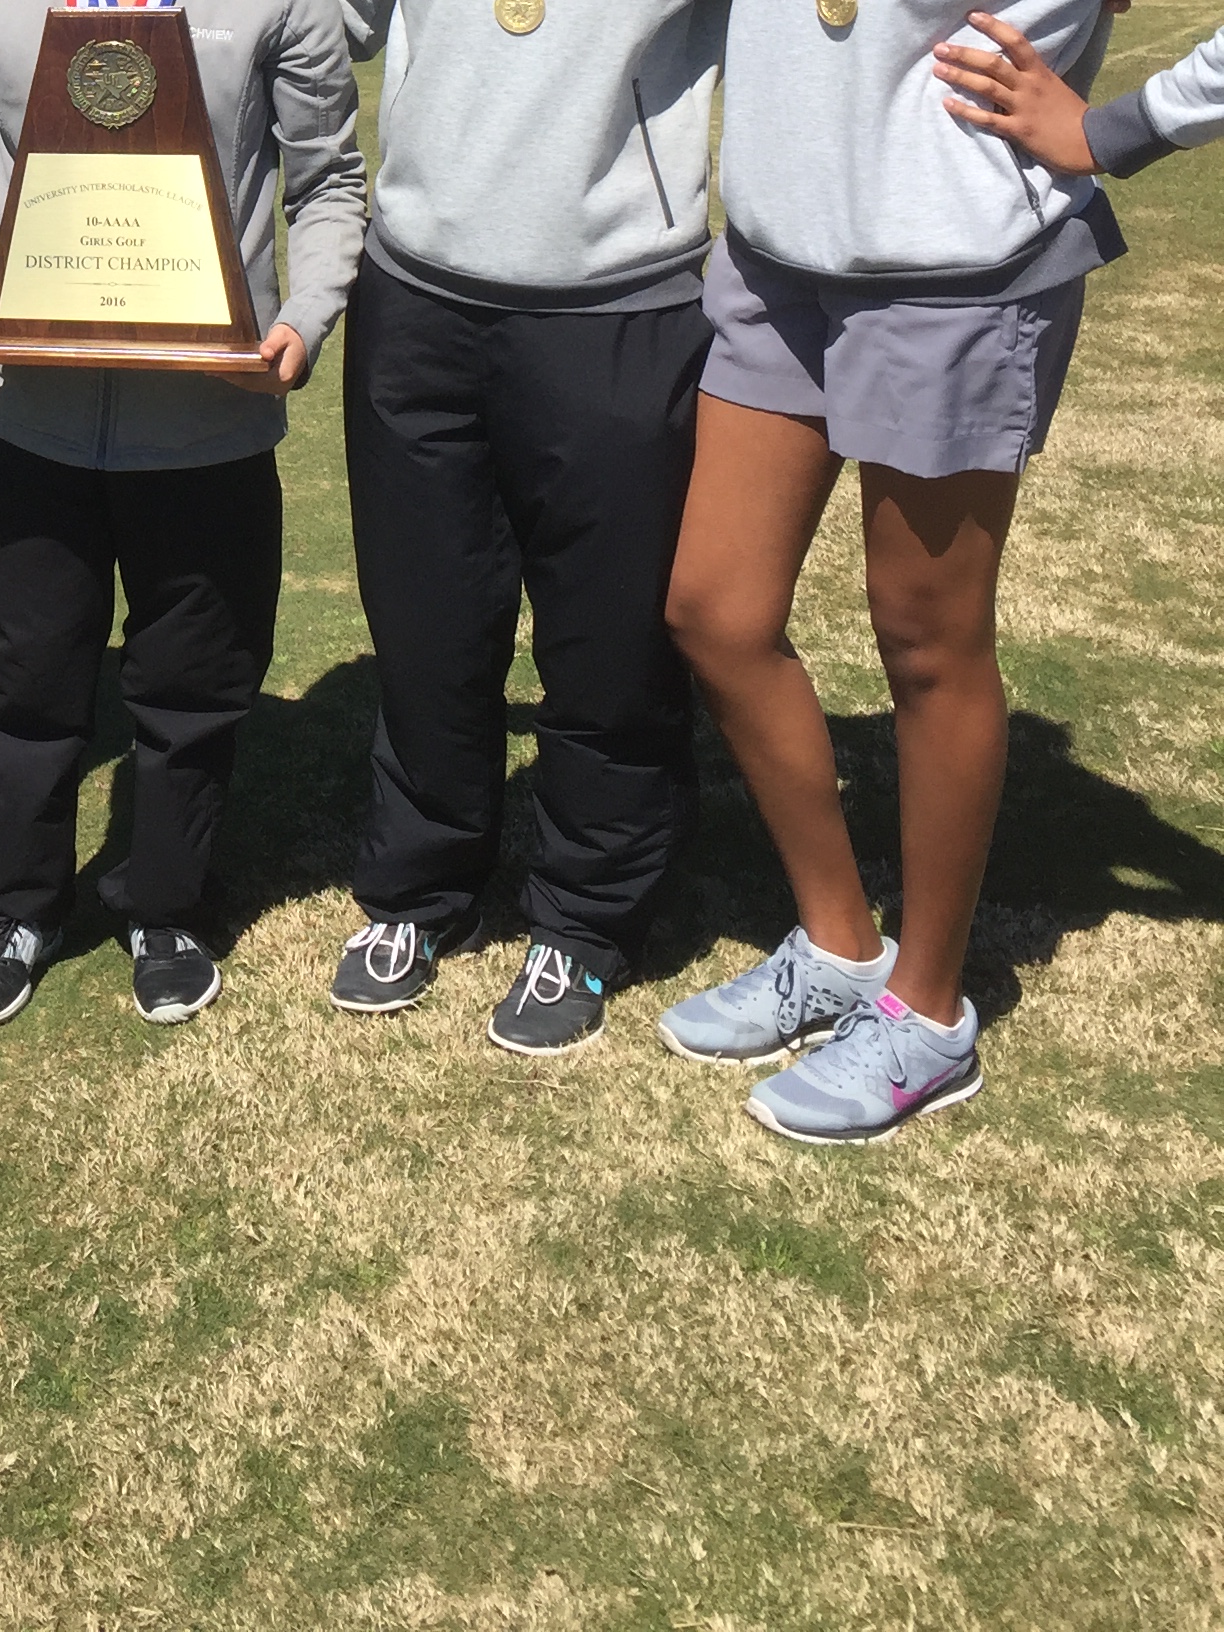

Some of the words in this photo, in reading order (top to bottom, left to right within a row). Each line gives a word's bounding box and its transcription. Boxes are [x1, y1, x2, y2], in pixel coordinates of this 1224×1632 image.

[189, 26, 234, 41] CHVIEW
[23, 185, 78, 209] UNIVERSITY
[79, 182, 165, 197] INTERSCHOLASTIC
[85, 216, 140, 228] 10-AAAA
[80, 235, 113, 247] GIRLS
[116, 236, 147, 248] GOLF
[25, 255, 104, 270] DISTRICT
[107, 256, 202, 272] CHAMPION
[100, 296, 126, 307] 2016
